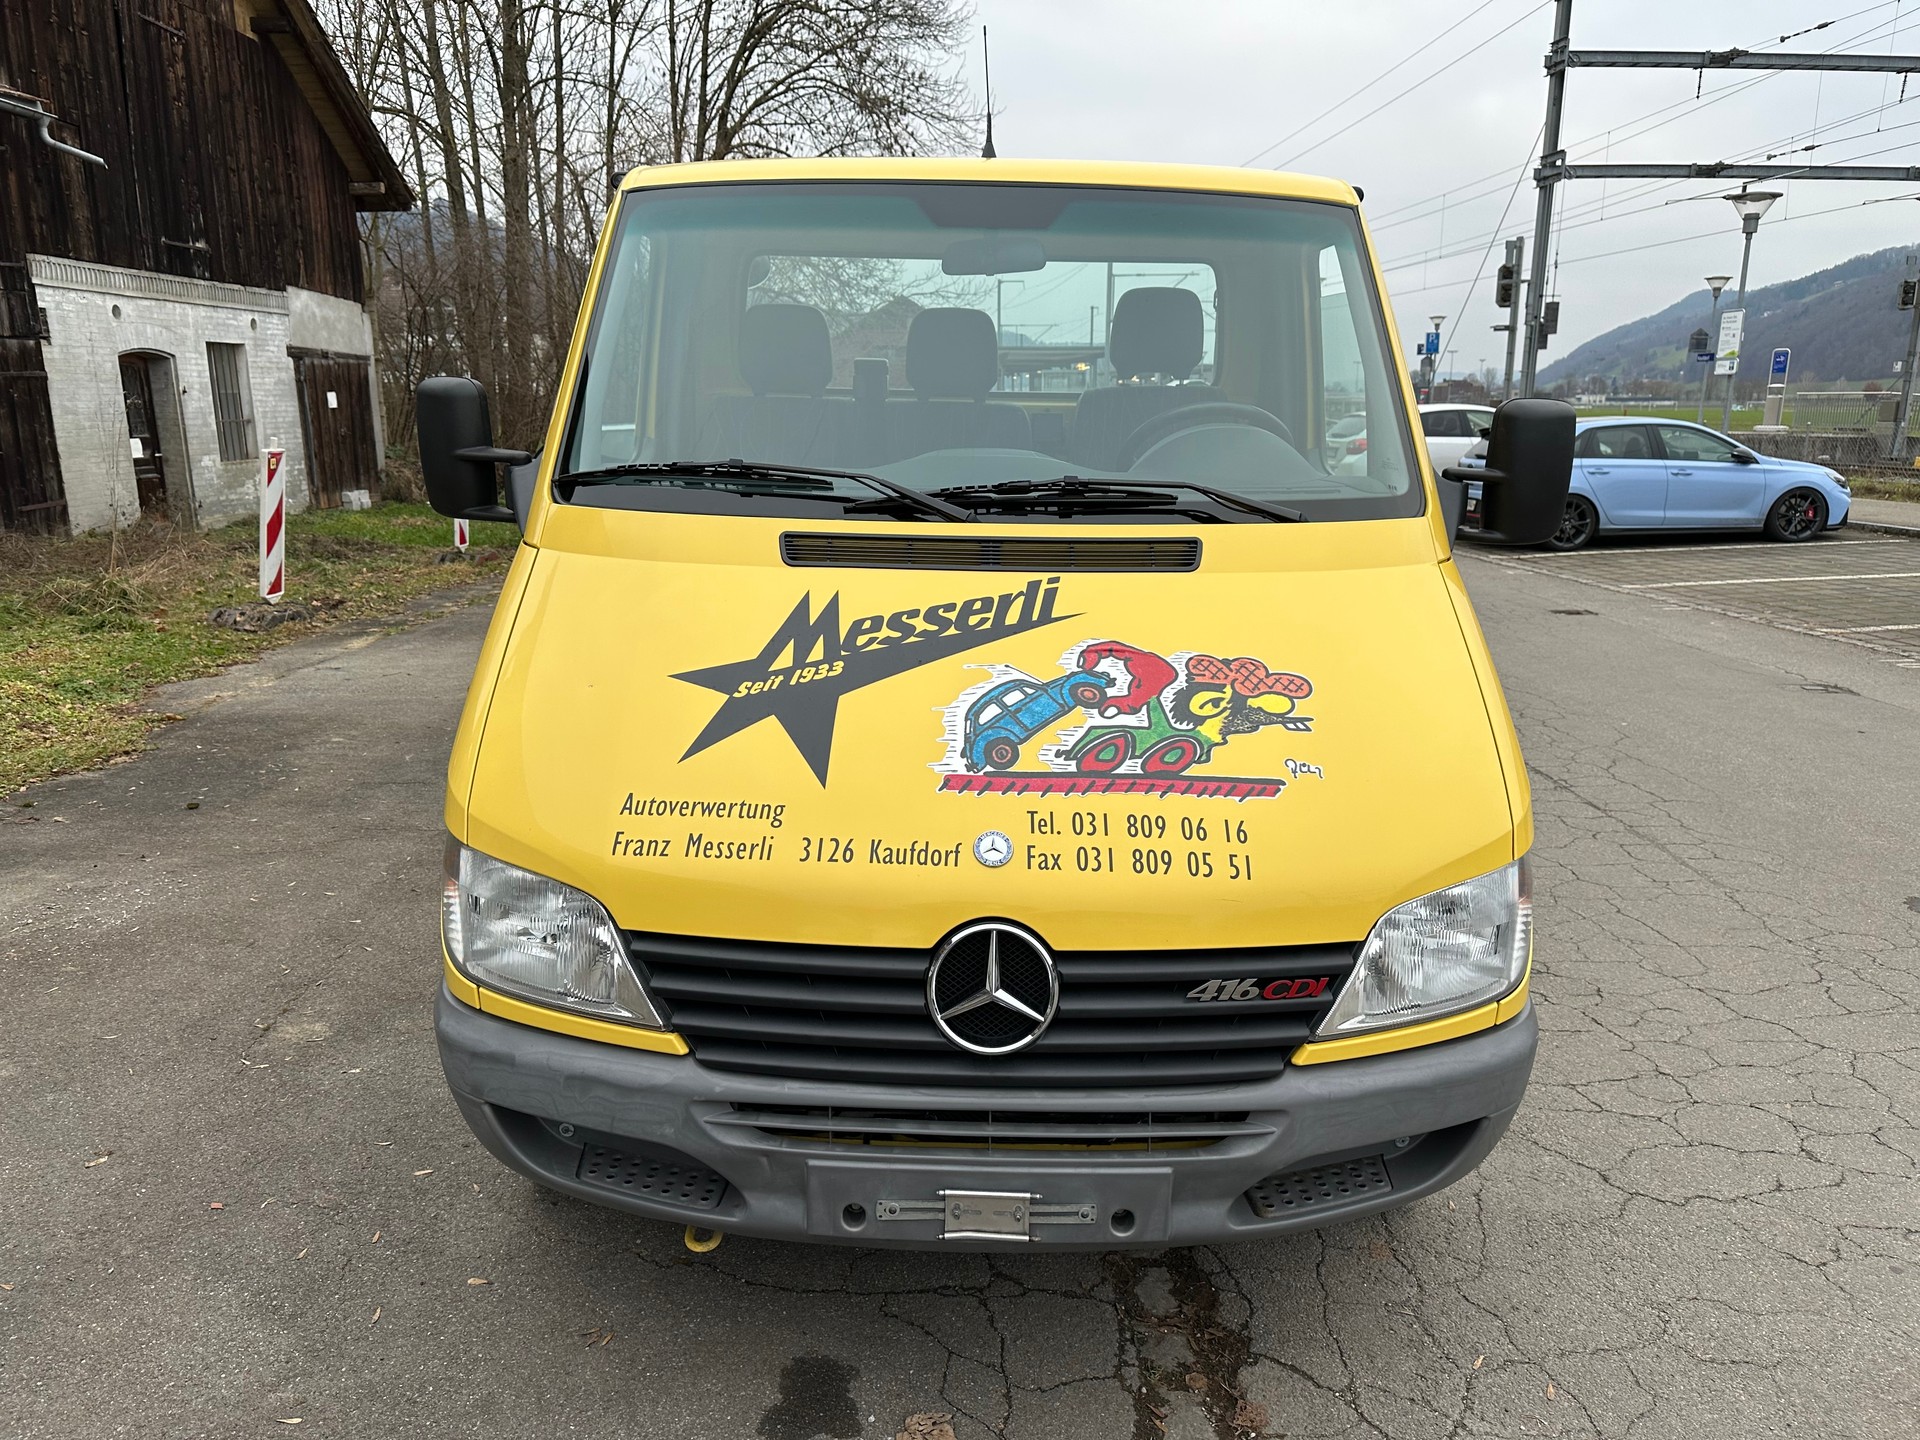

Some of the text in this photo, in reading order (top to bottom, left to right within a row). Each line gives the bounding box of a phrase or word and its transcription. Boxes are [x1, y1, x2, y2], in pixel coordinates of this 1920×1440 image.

[756, 576, 1061, 672] Messerli
[733, 661, 844, 698] Seit 1933
[619, 792, 786, 828] Autoverwertung
[1026, 810, 1248, 844] Tel. 031 809 06 16
[611, 831, 963, 868] Franz Messerli 3126 Kaufdorf
[1026, 844, 1252, 881] Fax 031 809 05 51
[1185, 977, 1330, 1002] 416 CDI
